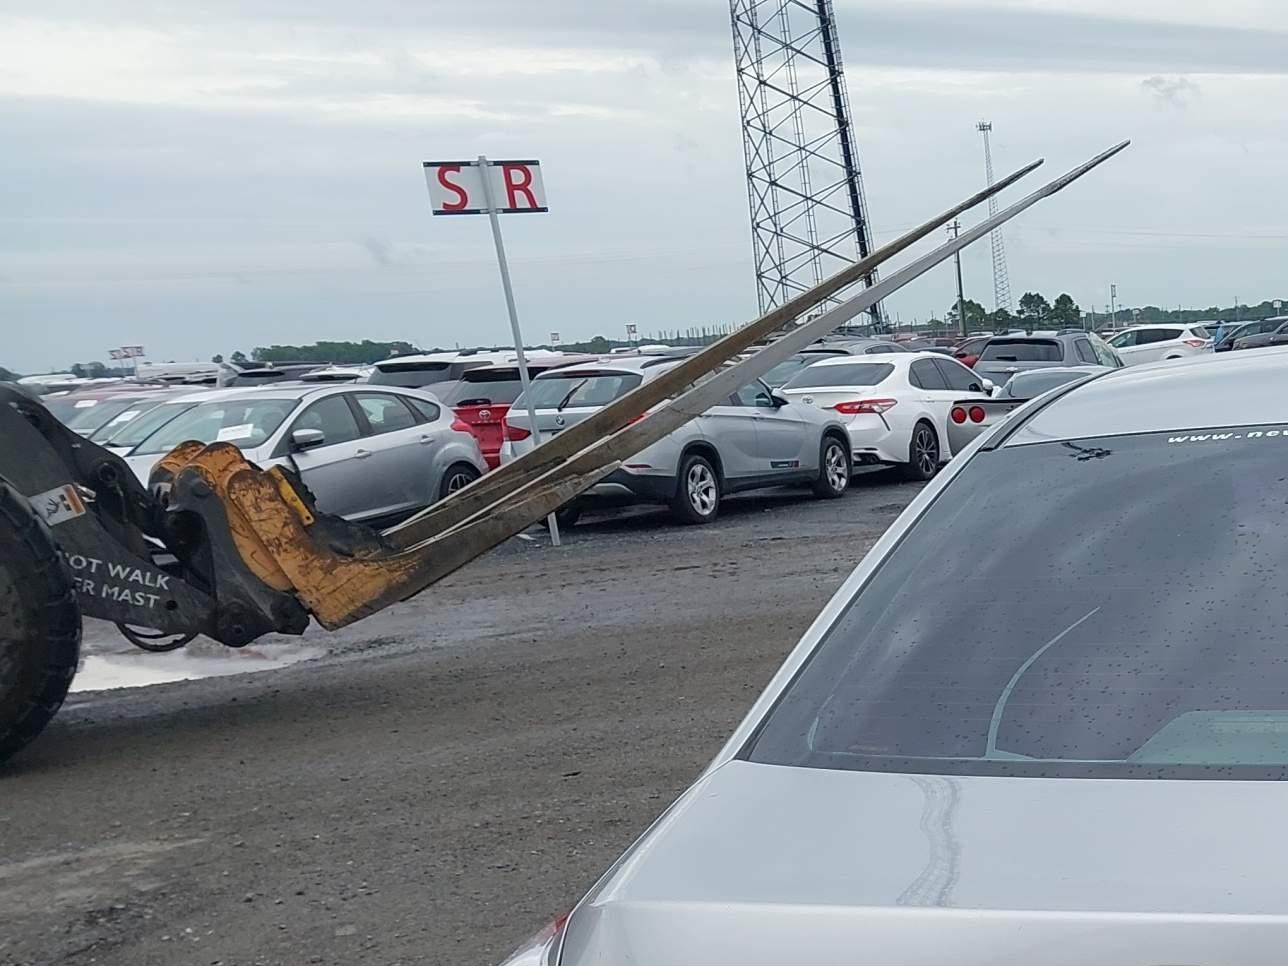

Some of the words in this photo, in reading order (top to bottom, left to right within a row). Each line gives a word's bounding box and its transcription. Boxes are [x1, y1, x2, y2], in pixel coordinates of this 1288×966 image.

[437, 164, 468, 210] S
[503, 164, 539, 209] R
[66, 553, 103, 573] OT
[108, 562, 170, 590] WALK
[101, 584, 161, 609] MAST
